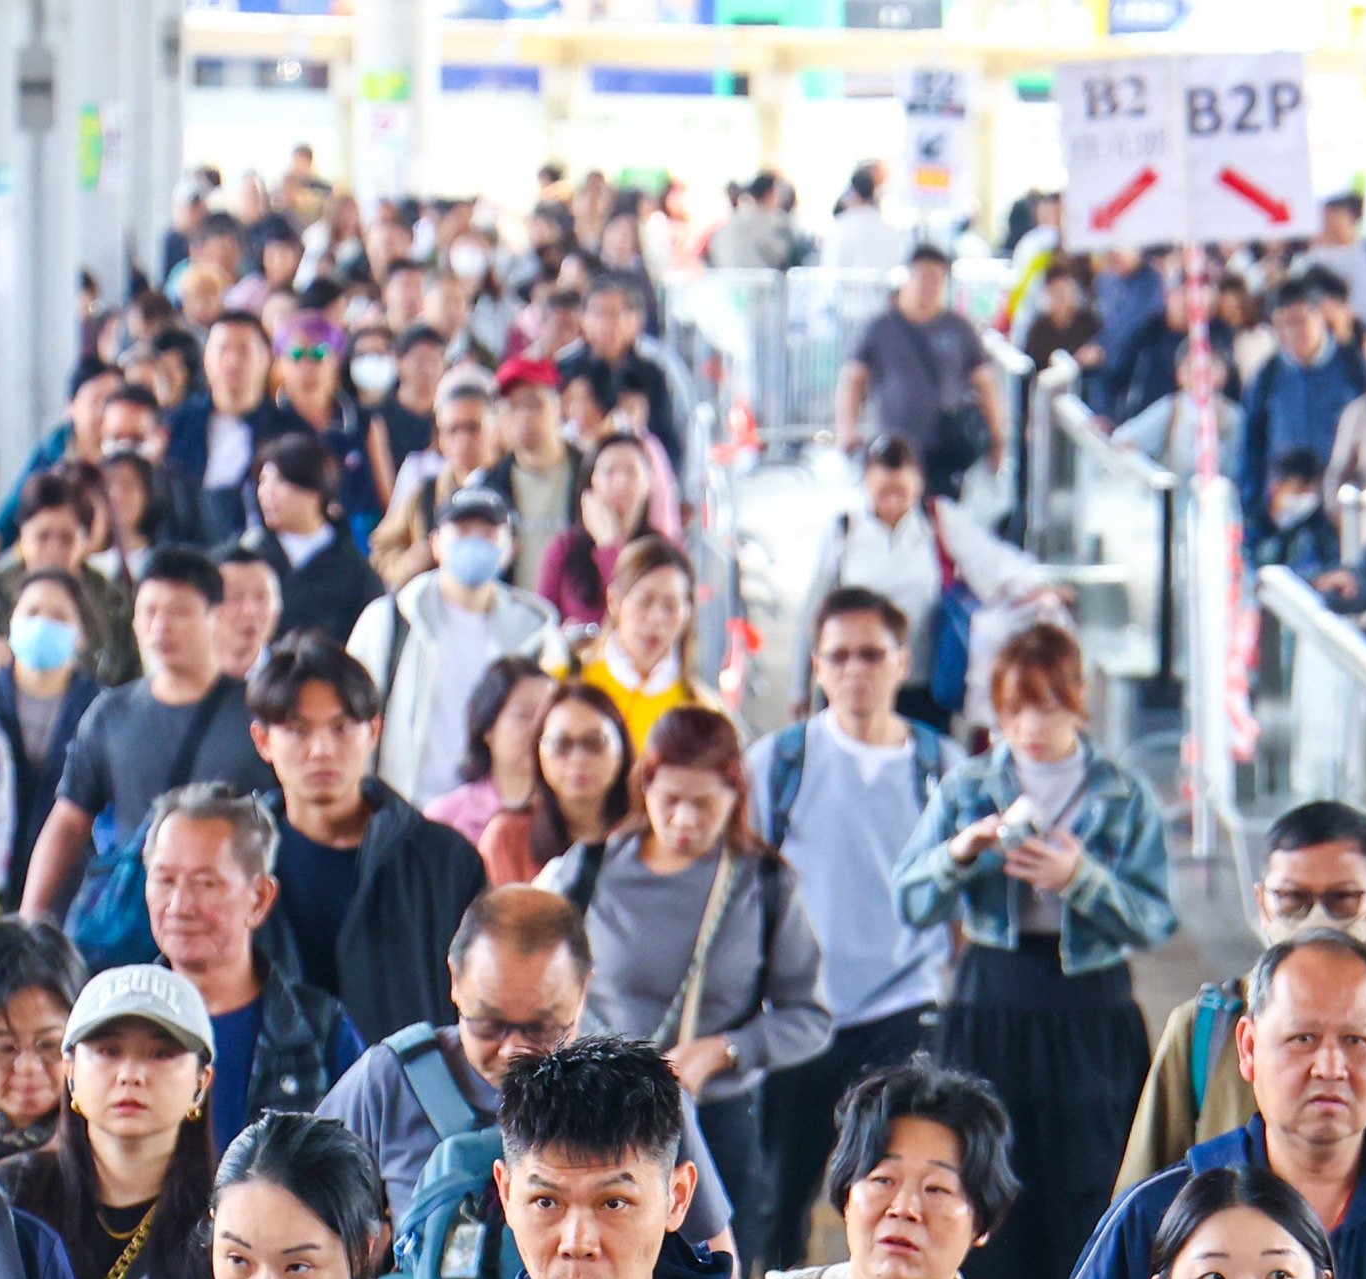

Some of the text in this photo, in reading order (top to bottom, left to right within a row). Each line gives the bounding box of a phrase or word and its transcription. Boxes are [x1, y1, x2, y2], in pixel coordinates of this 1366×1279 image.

[1084, 76, 1301, 137] B2 B2P
[98, 969, 182, 1016] SEOUL
